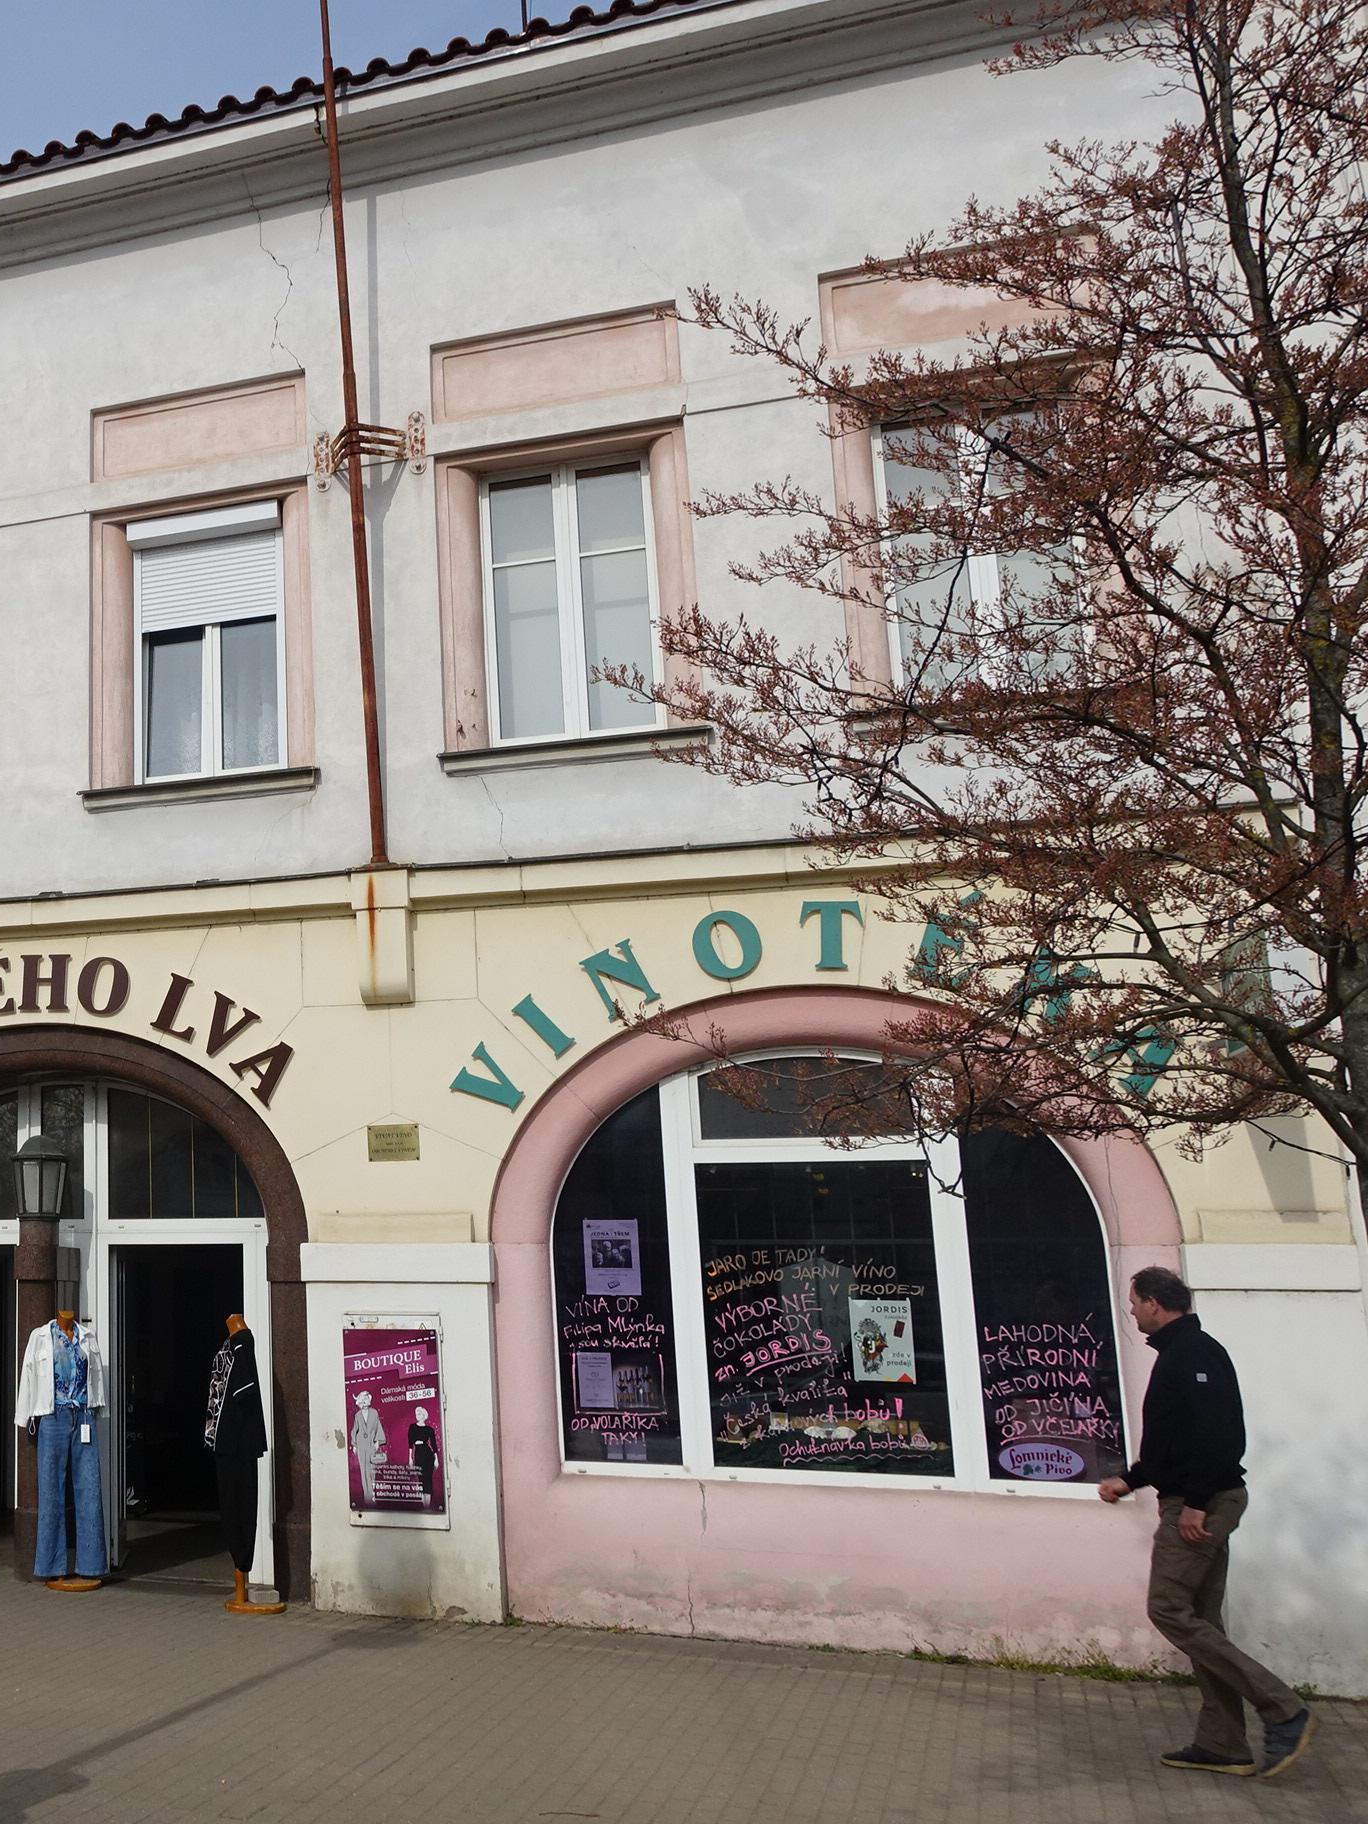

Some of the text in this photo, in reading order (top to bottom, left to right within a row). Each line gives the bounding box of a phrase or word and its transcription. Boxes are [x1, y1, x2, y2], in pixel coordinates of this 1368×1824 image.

[150, 972, 294, 1109] LVA
[707, 1254, 747, 1277] JARO
[751, 1250, 771, 1265] JE
[851, 1258, 896, 1278] VÍNO
[848, 1284, 925, 1296] PRODEJI
[565, 1294, 639, 1317] VÍNA OD
[871, 1305, 908, 1313] JORDIS
[740, 1329, 832, 1368] JORDIS
[353, 1349, 422, 1371] BOUTIQUE
[405, 1362, 425, 1375] Elis
[984, 1371, 1092, 1400] MEDOVINA
[995, 1405, 1018, 1424] OD
[571, 1419, 589, 1431] OD
[1001, 1421, 1027, 1438] OD
[1007, 1448, 1073, 1470] Lomnické
[1046, 1463, 1073, 1475] Pivo
